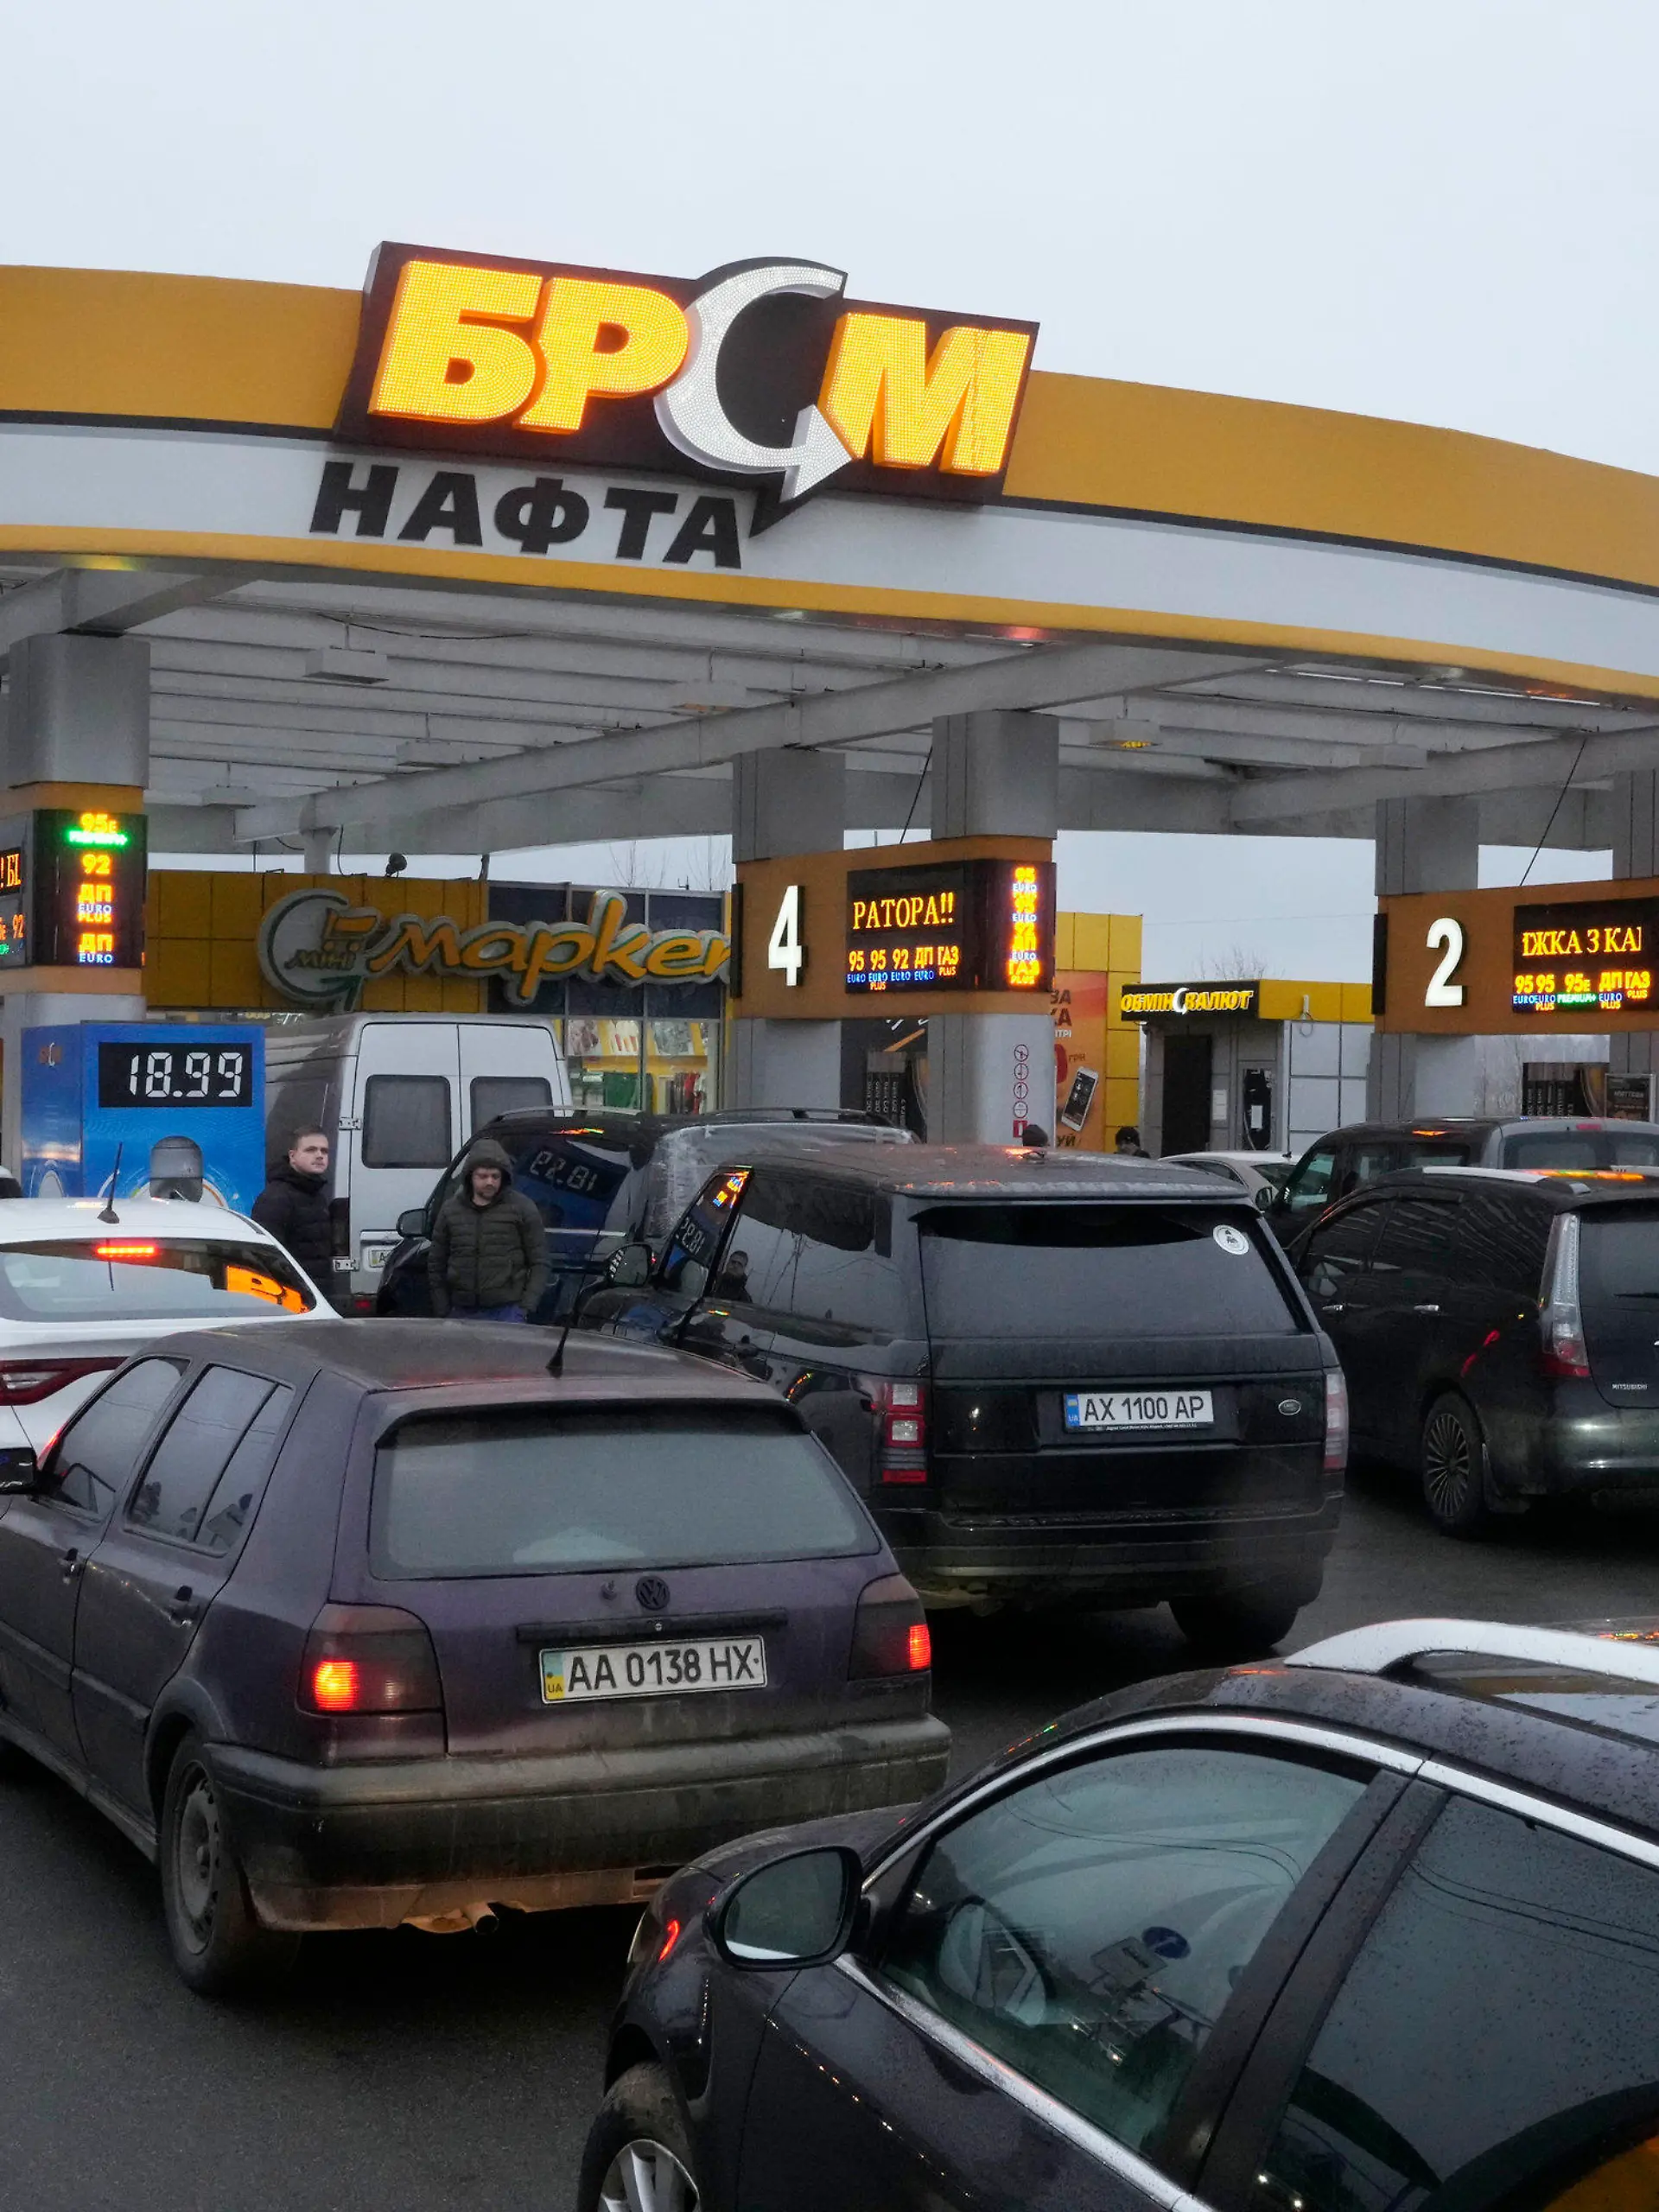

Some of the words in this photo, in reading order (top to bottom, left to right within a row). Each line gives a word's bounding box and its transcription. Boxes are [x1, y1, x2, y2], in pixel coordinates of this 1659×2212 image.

[368, 260, 1031, 499] БРСМ
[308, 461, 742, 569] НАФТА
[82, 854, 111, 874] 92
[78, 883, 112, 904] ДП
[1012, 883, 1037, 892] EURO
[78, 904, 112, 913] EURO
[78, 912, 112, 923] PLUS
[1012, 913, 1037, 922] EURO
[79, 933, 113, 953] ДП
[768, 885, 802, 986] 4
[79, 953, 113, 963] EURO
[849, 950, 865, 971] 95
[870, 950, 887, 970] 95
[893, 949, 908, 969] 92
[914, 947, 933, 969] ДП
[937, 945, 959, 966] ГАЗ
[1011, 951, 1037, 961] EURO
[1425, 918, 1463, 1007] 2
[847, 974, 865, 983] EURO
[868, 972, 887, 982] EURO
[891, 971, 911, 982] EURO
[914, 970, 934, 981] EURO
[939, 966, 957, 976] PLUS
[1515, 975, 1534, 994] 95
[1535, 974, 1555, 993] 95
[1599, 972, 1623, 992] ДП
[1624, 971, 1651, 989] ГАЗ
[870, 981, 887, 991] PLUS
[1184, 990, 1254, 1010] ВАЛЮТ
[1513, 995, 1535, 1004] EURO
[1535, 995, 1555, 1003] EURO
[1599, 993, 1623, 1001] EURO
[1627, 989, 1648, 999] PLUS
[1535, 1002, 1555, 1011] PLUS
[1601, 1001, 1621, 1009] PLUS
[130, 1052, 243, 1098] 18.99
[1084, 1397, 1116, 1421] AX
[1122, 1396, 1167, 1420] 1100
[1175, 1395, 1204, 1419] AP
[568, 1654, 617, 1692] AA
[626, 1649, 702, 1687] 0138
[709, 1644, 755, 1681] HX
[548, 1684, 563, 1693] UA
